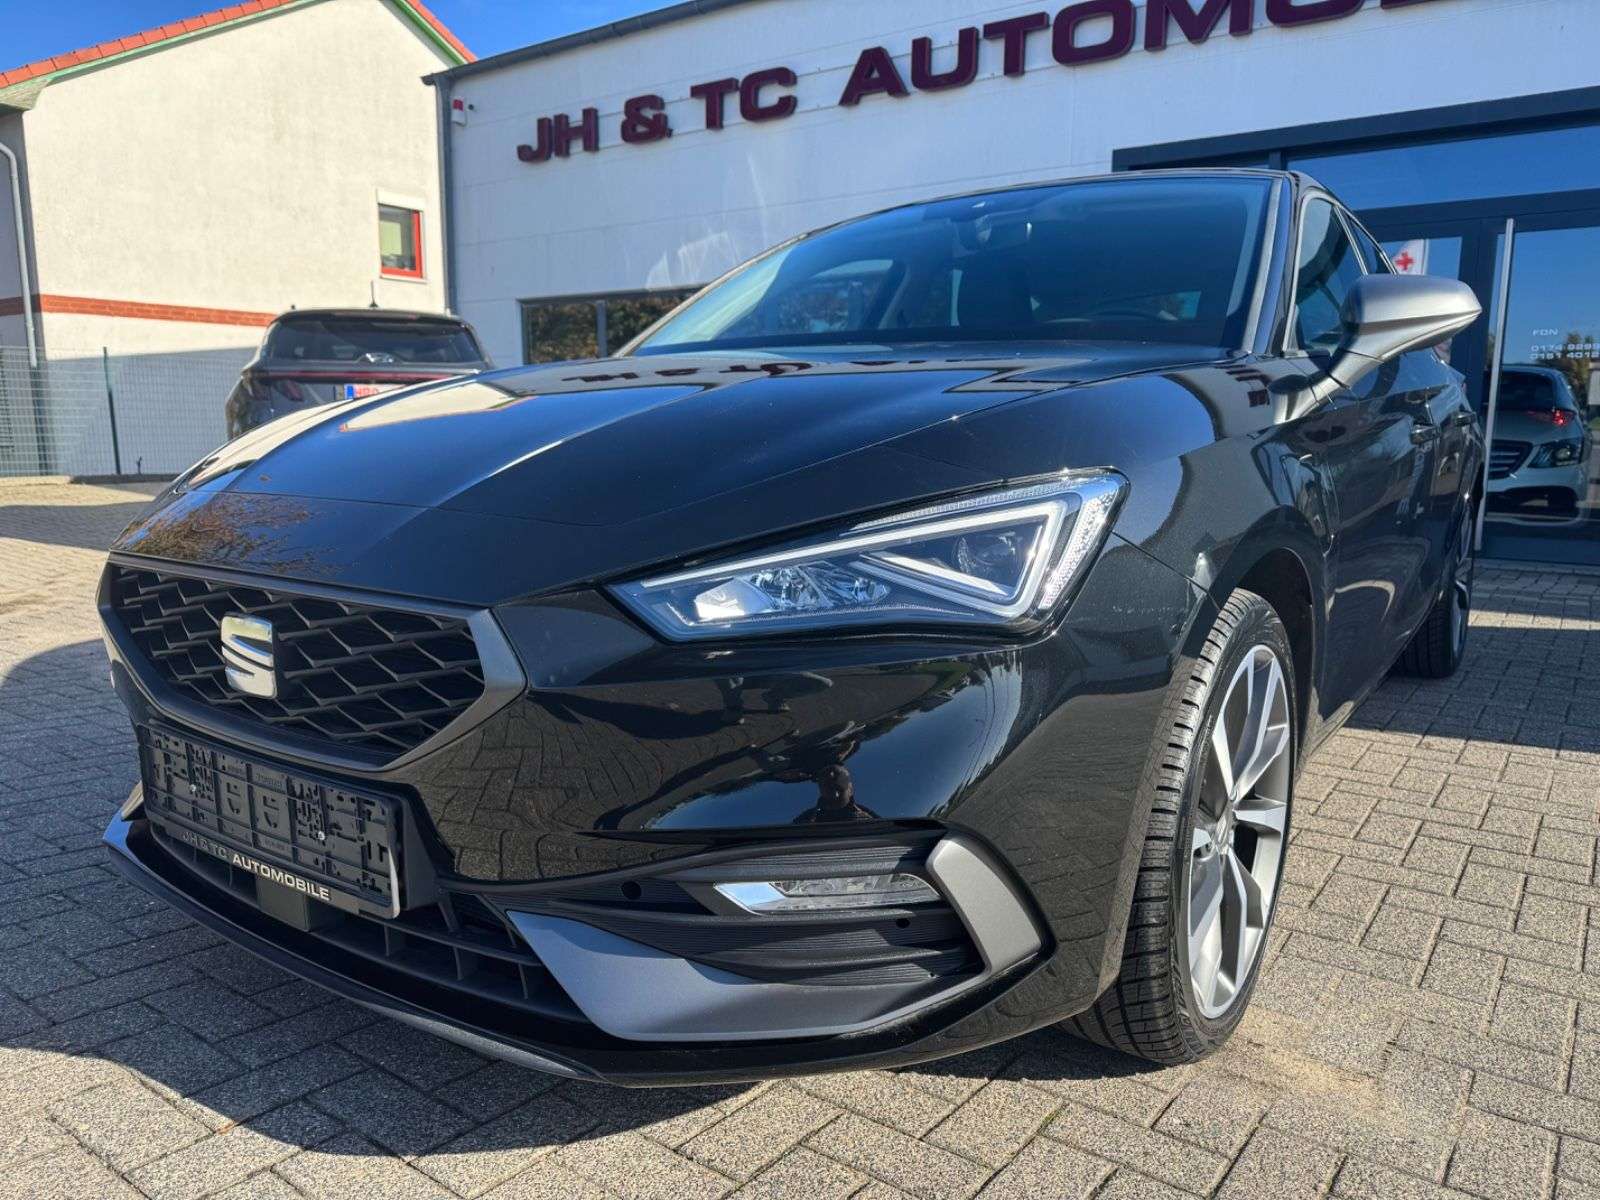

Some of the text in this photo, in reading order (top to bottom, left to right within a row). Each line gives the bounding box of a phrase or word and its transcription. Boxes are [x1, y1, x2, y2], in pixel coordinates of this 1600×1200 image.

[516, 0, 1430, 162] JH & TC AUTOM
[232, 853, 330, 901] AUTOMOBILE
